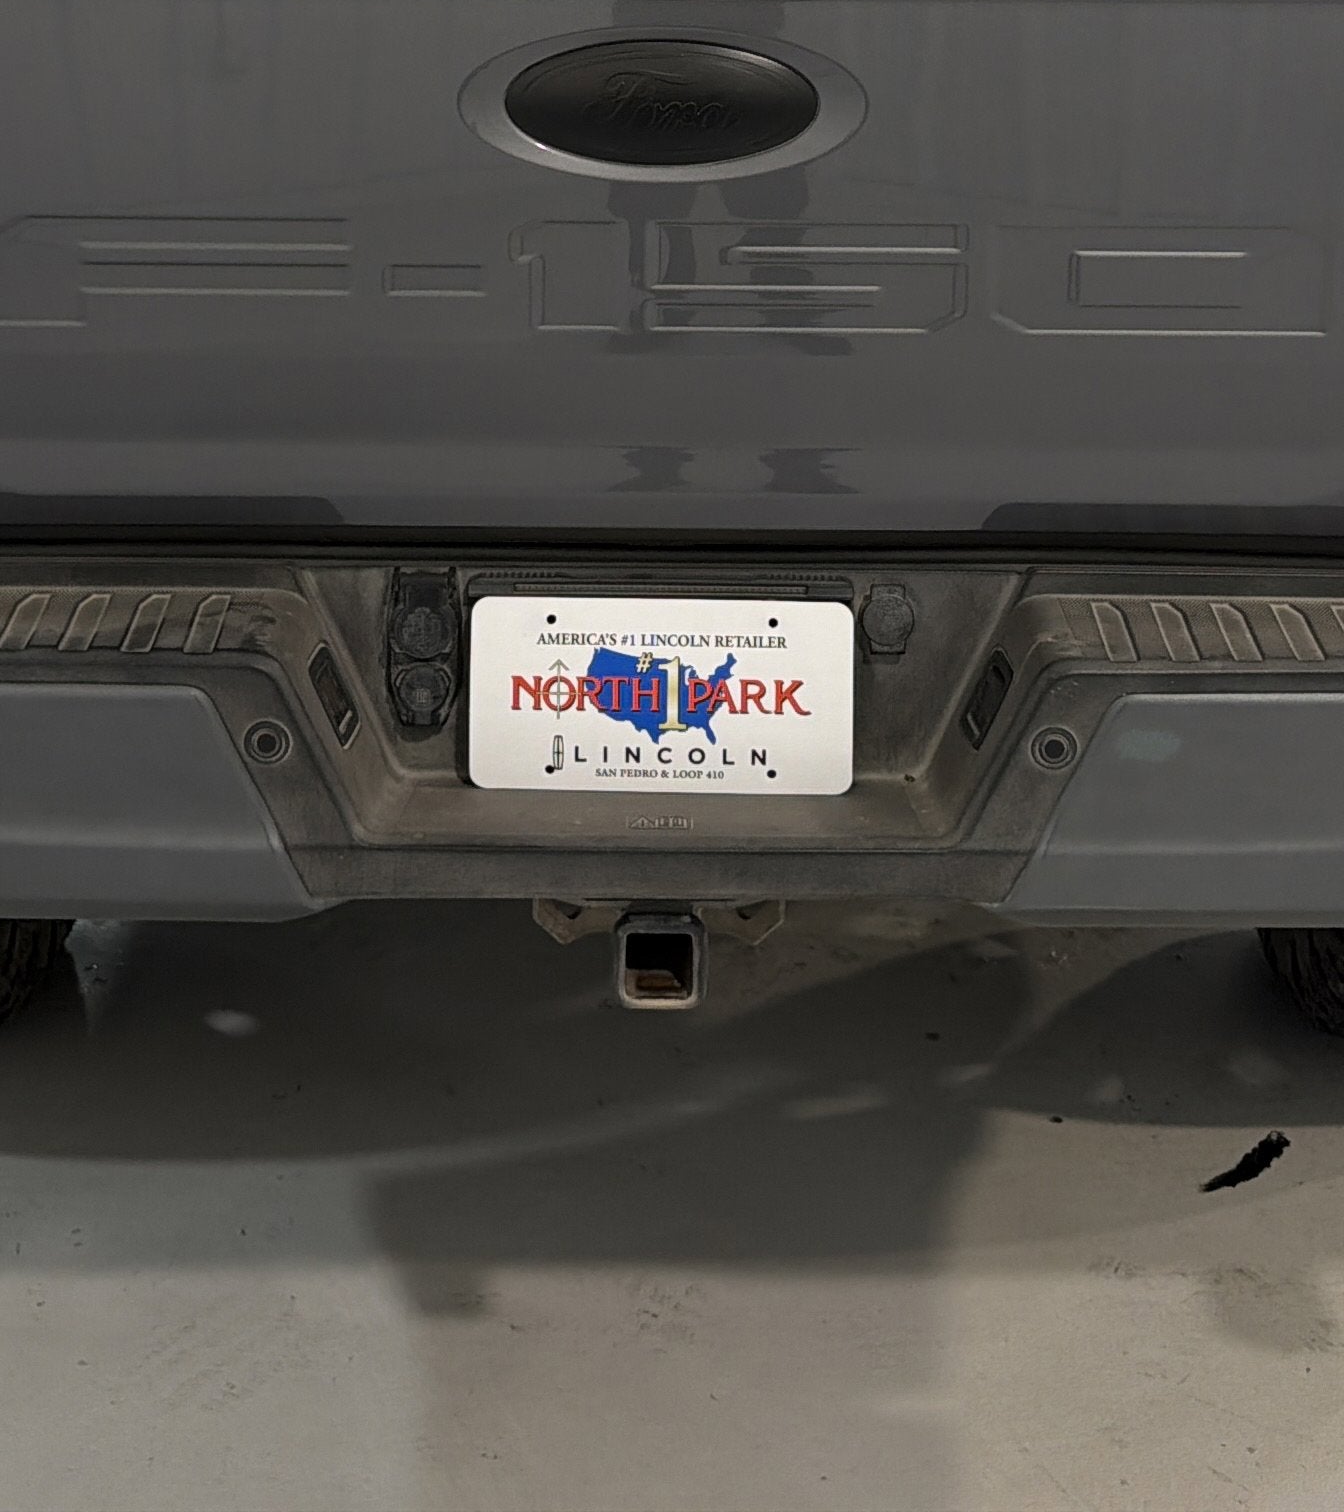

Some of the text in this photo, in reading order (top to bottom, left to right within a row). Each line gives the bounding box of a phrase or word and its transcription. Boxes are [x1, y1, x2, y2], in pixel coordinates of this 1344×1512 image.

[536, 632, 788, 649] AMERICA'S #1 LINCOLN RETAILER
[511, 675, 812, 716] NORTH PARK
[574, 745, 767, 767] LINCOLN
[595, 768, 725, 780] SAN PEDRO & LOOP 410
